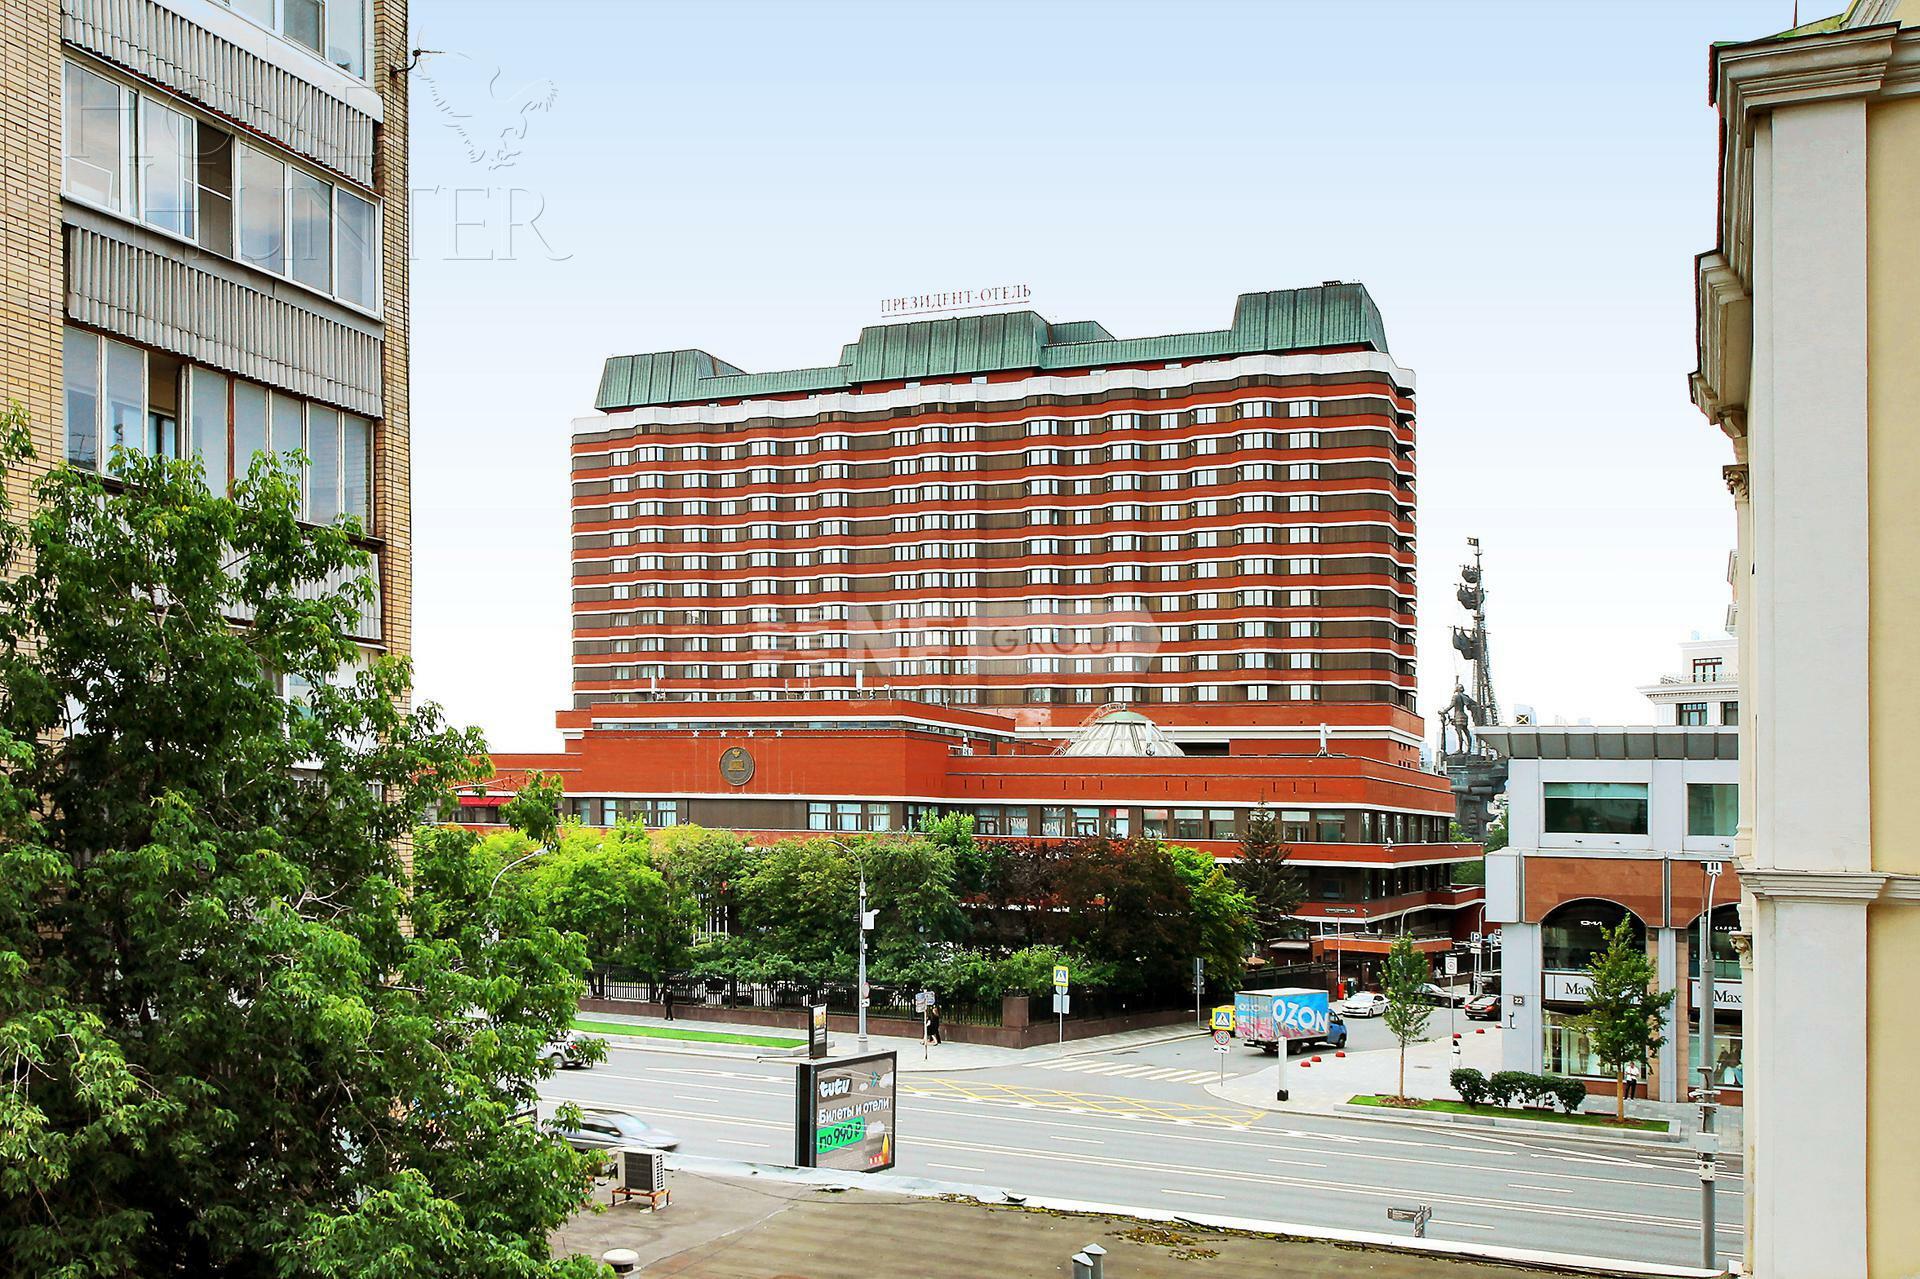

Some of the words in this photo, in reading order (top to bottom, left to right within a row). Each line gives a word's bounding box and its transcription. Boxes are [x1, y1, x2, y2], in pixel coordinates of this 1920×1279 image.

[881, 284, 1031, 312] ПРЕЗИДЕНТ-ОТЕЛЬ
[1565, 982, 1591, 995] Ma
[1713, 989, 1743, 1004] Max
[1273, 999, 1329, 1032] OZON
[818, 1105, 855, 1123] Билеты
[855, 1104, 862, 1115] и
[863, 1098, 890, 1113] отели
[833, 1125, 853, 1144] 990
